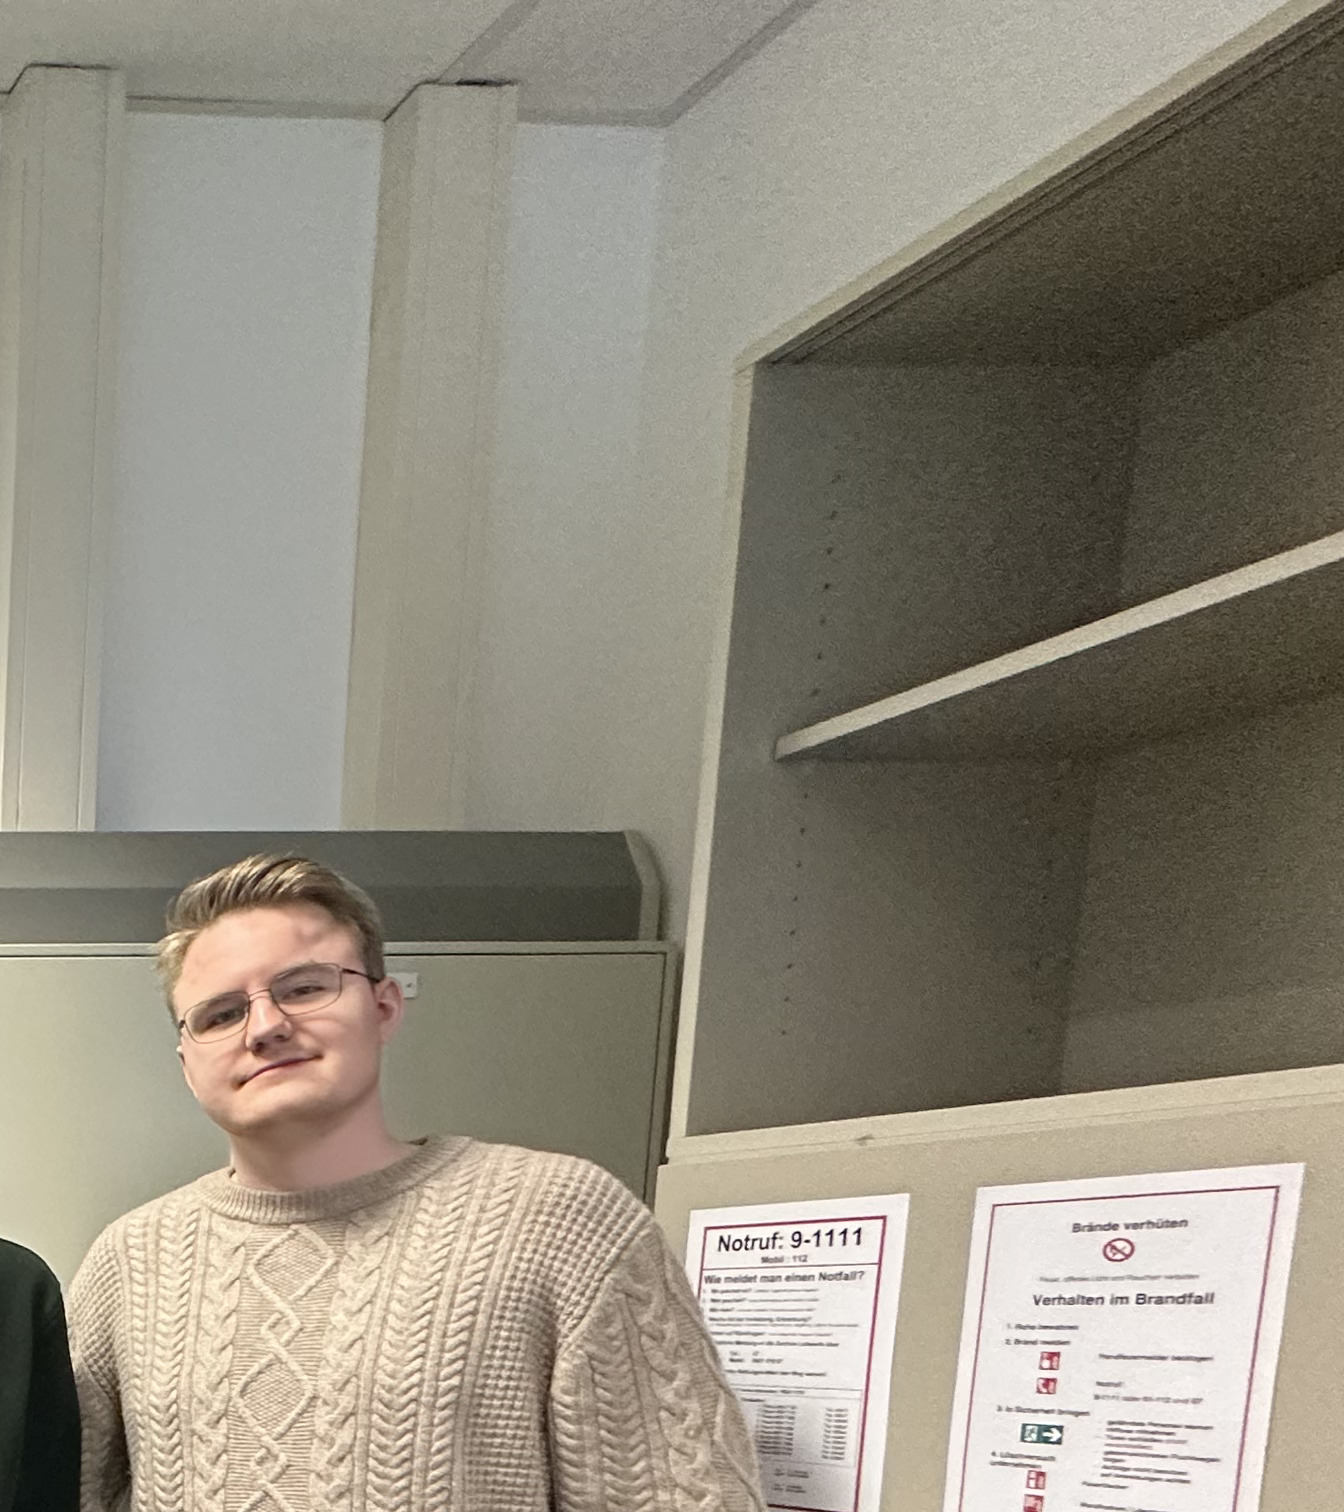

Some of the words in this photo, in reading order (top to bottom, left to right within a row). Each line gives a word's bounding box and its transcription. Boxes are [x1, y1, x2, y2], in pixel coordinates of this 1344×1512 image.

[1072, 1222, 1119, 1234] Brände
[1124, 1217, 1189, 1230] verhüten
[717, 1232, 785, 1252] Notruf:
[790, 1227, 863, 1248] 9-1111
[703, 1275, 722, 1285] Wie
[723, 1273, 757, 1284] meldet
[759, 1274, 782, 1284] man
[784, 1272, 815, 1283] einen
[818, 1270, 866, 1282] Notfall?
[1032, 1293, 1105, 1306] Verhalten
[1109, 1293, 1130, 1306] im
[1135, 1291, 1216, 1305] Brandfall
